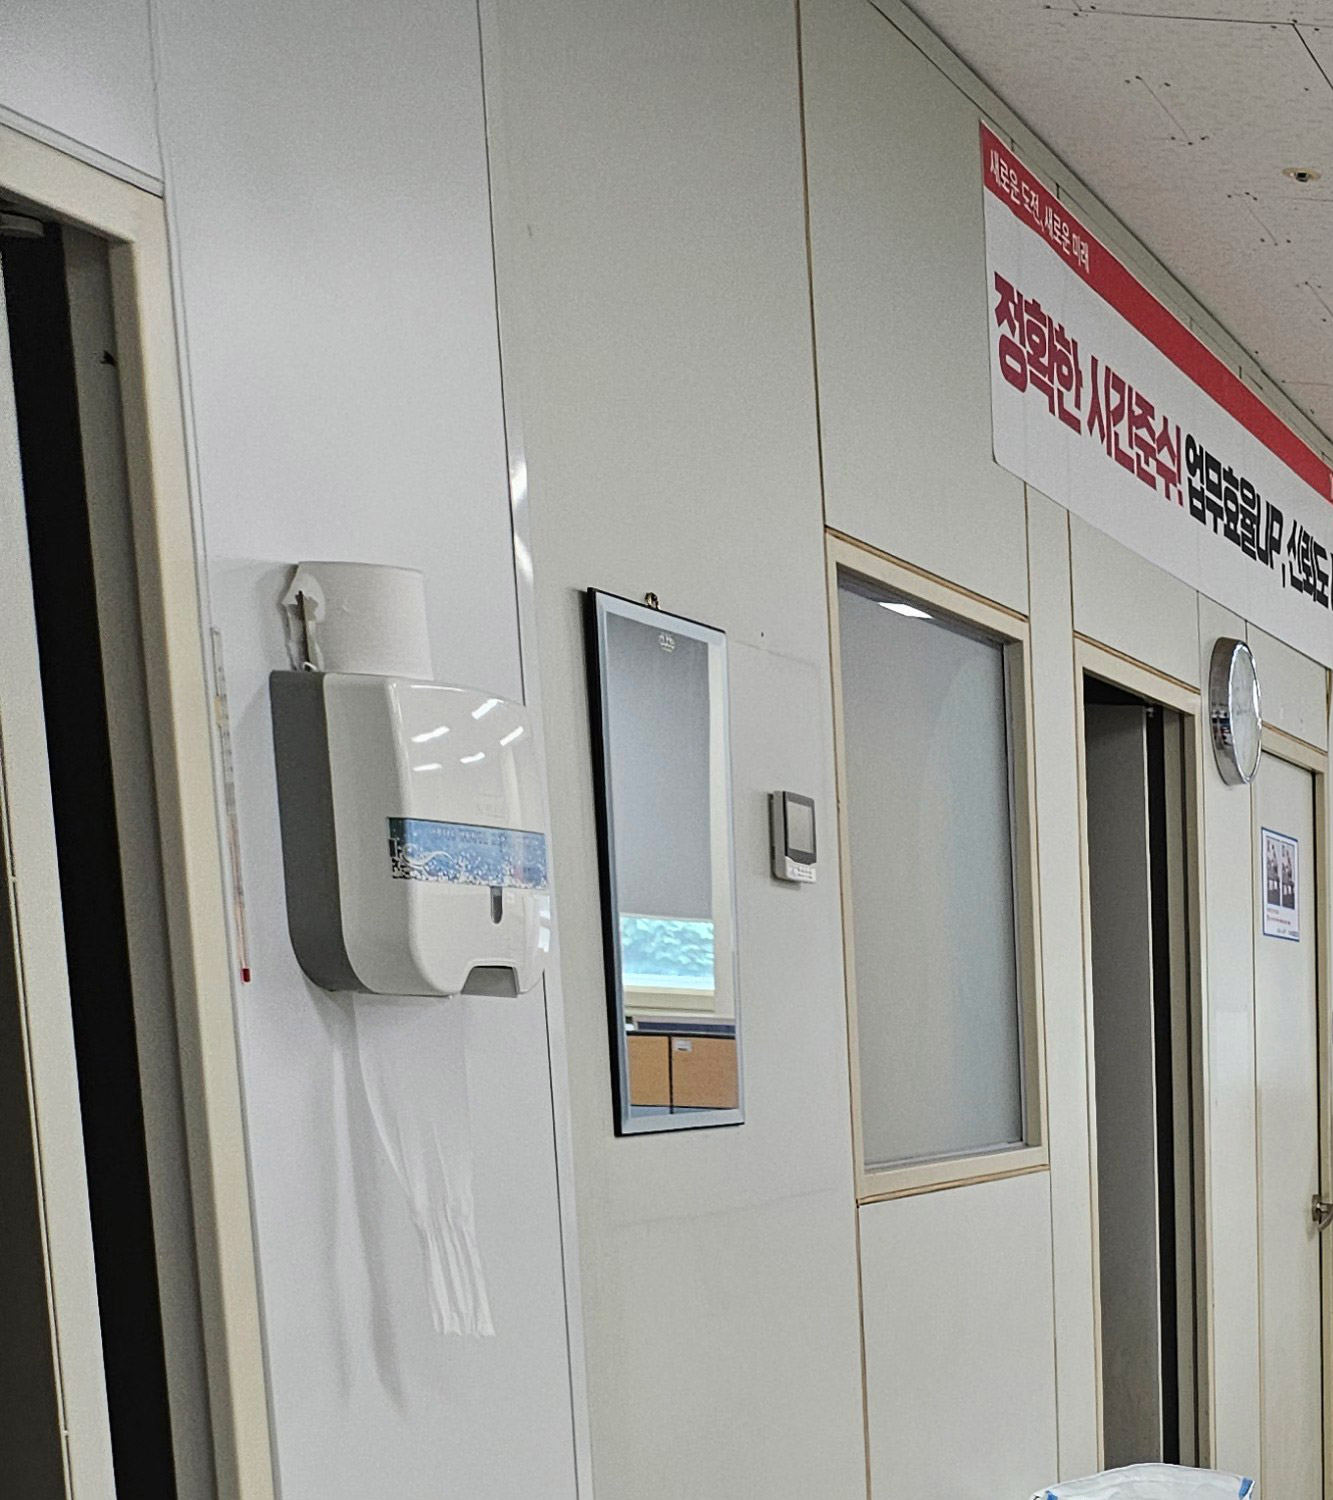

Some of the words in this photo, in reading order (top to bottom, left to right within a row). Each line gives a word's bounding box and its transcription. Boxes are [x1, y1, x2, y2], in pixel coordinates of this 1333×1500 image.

[989, 149, 1021, 205] 새로운
[1042, 204, 1071, 249] 새로운
[1071, 232, 1090, 273] 미래
[994, 271, 1084, 433] 정확한
[1088, 355, 1183, 507] 시간준수!
[1184, 433, 1285, 588] 업무효율UP,
